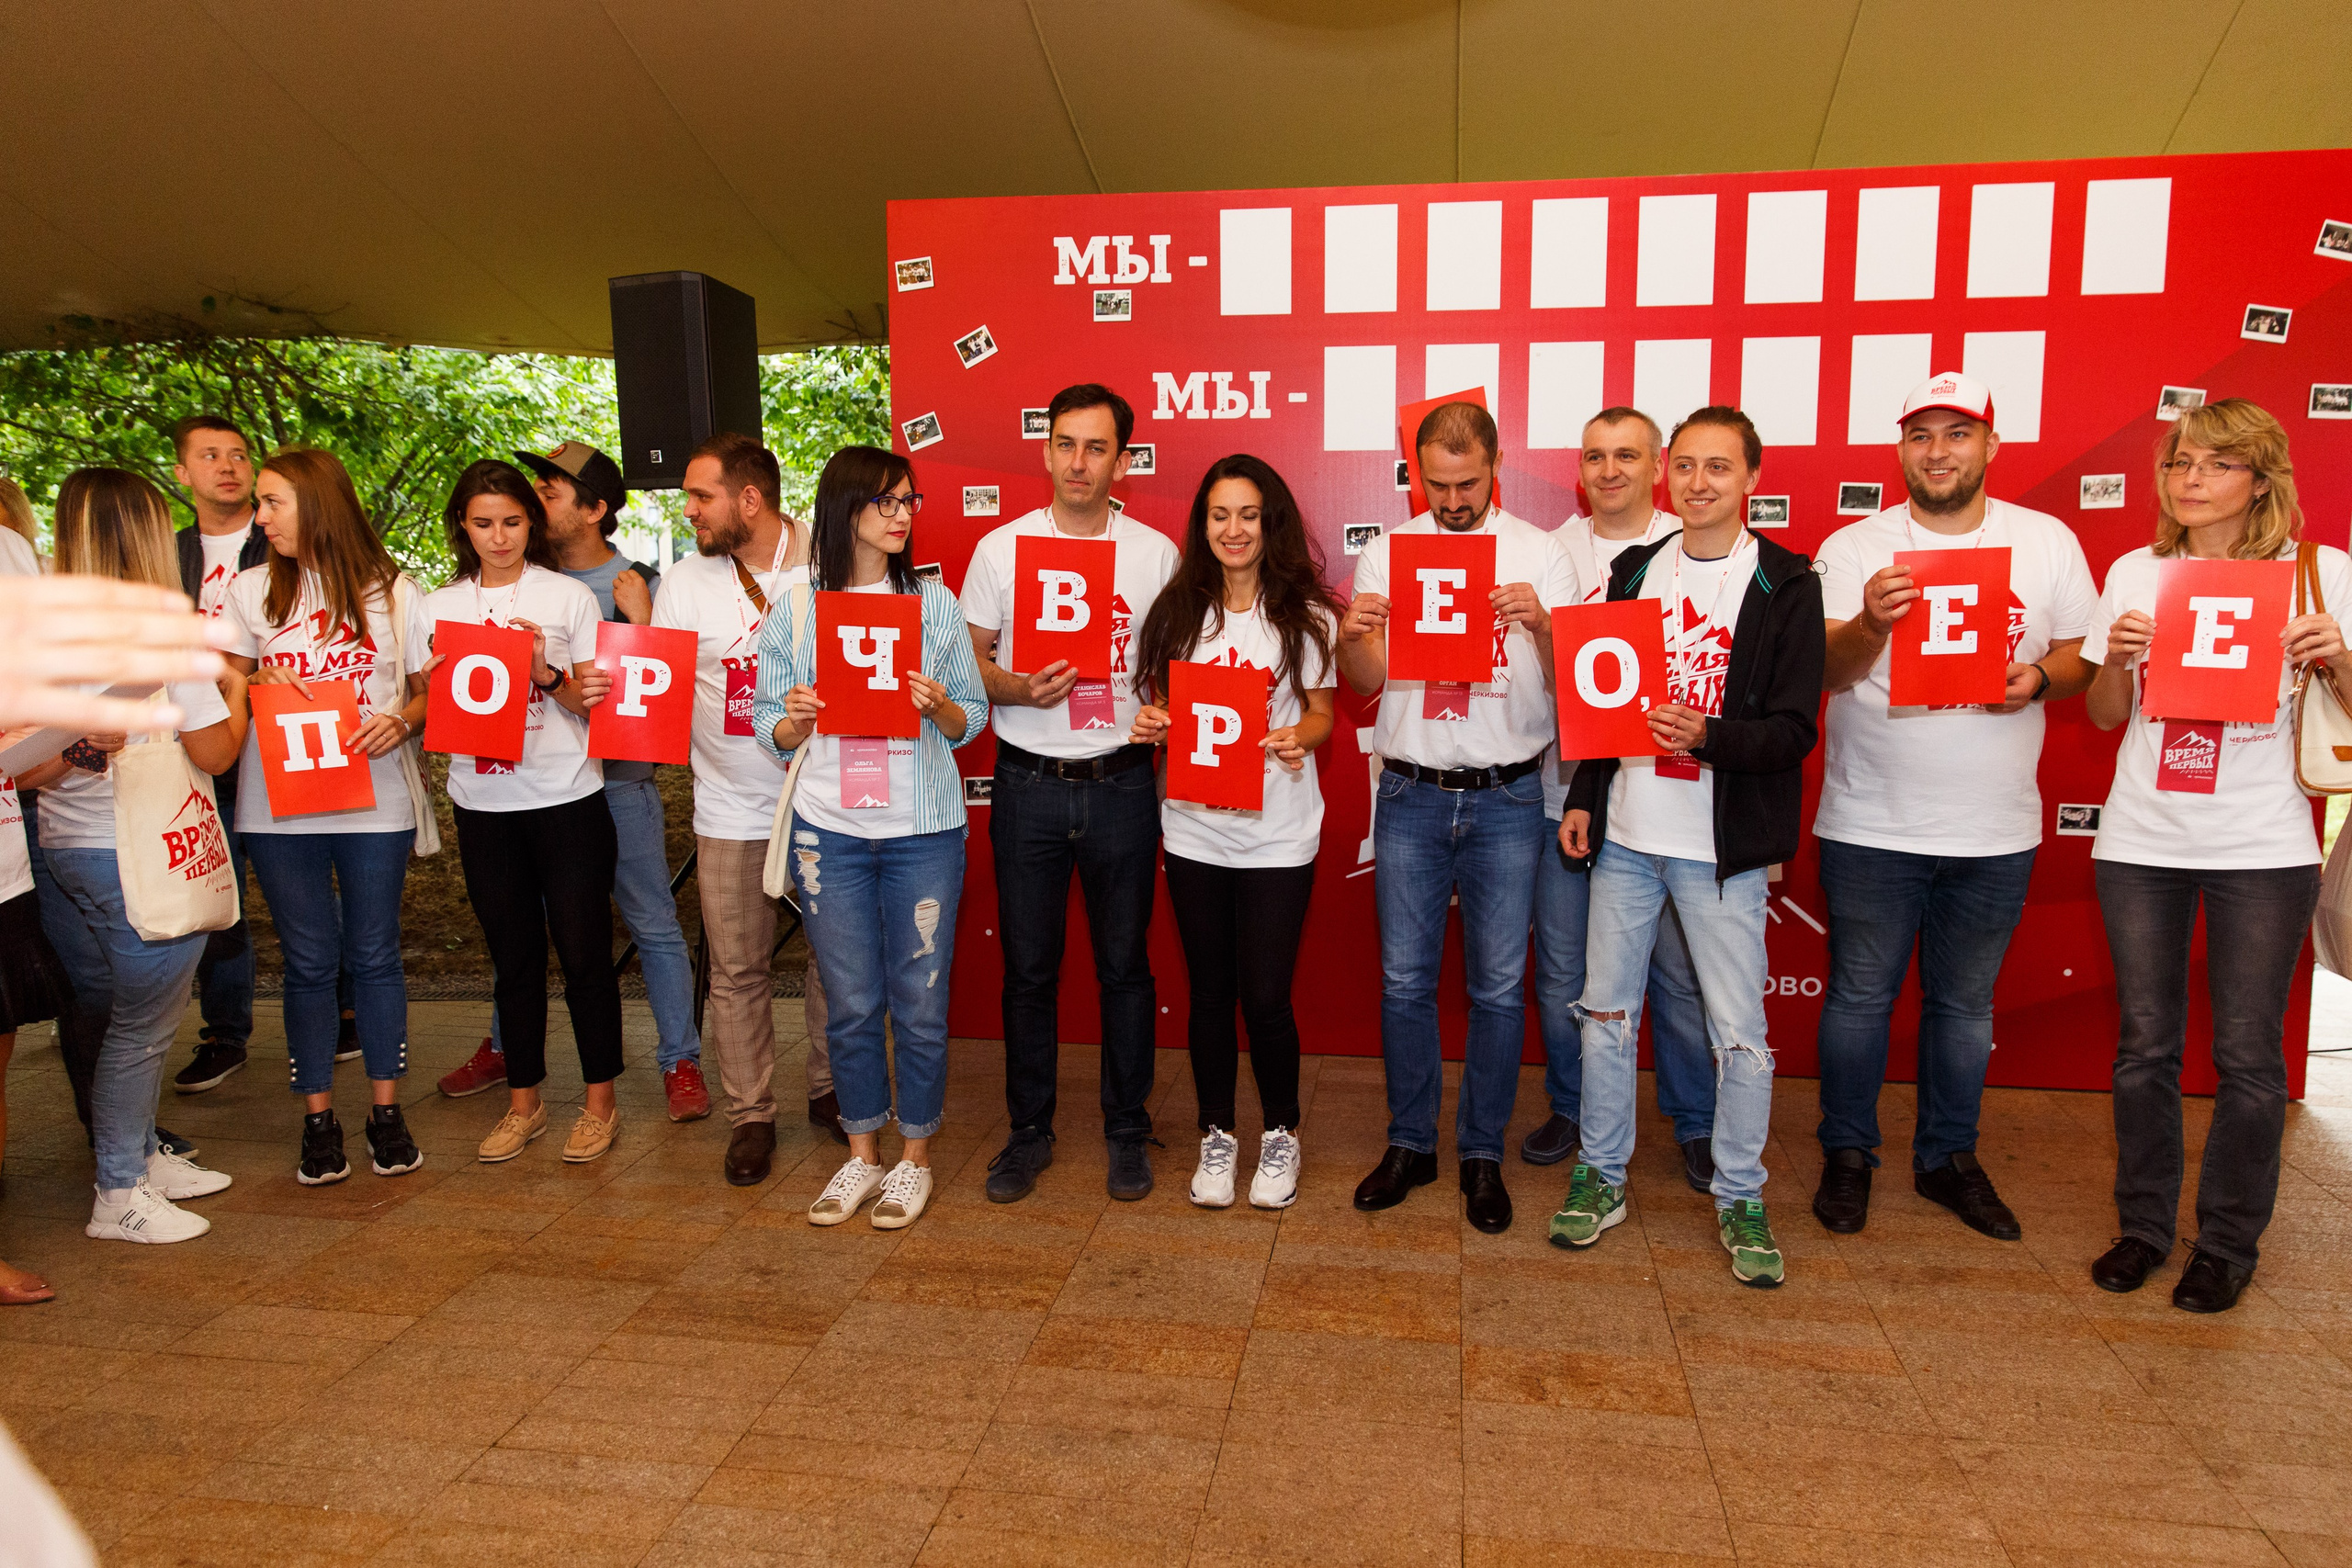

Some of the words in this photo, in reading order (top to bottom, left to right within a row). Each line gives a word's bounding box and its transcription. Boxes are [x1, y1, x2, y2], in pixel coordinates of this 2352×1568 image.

[1053, 234, 1172, 285] МЫ
[1151, 371, 1272, 420] МЫ
[1036, 570, 1091, 632] В
[1416, 569, 1466, 634] Е
[1921, 584, 1978, 655] Е
[838, 626, 899, 690] Ч
[2181, 596, 2254, 669] Е
[451, 654, 510, 715] О
[614, 650, 672, 717] Р
[276, 710, 348, 772] П
[1191, 703, 1241, 767] Р
[2164, 747, 2215, 764] ВРЕМЯ
[2169, 753, 2216, 770] ПЕРВЫХ
